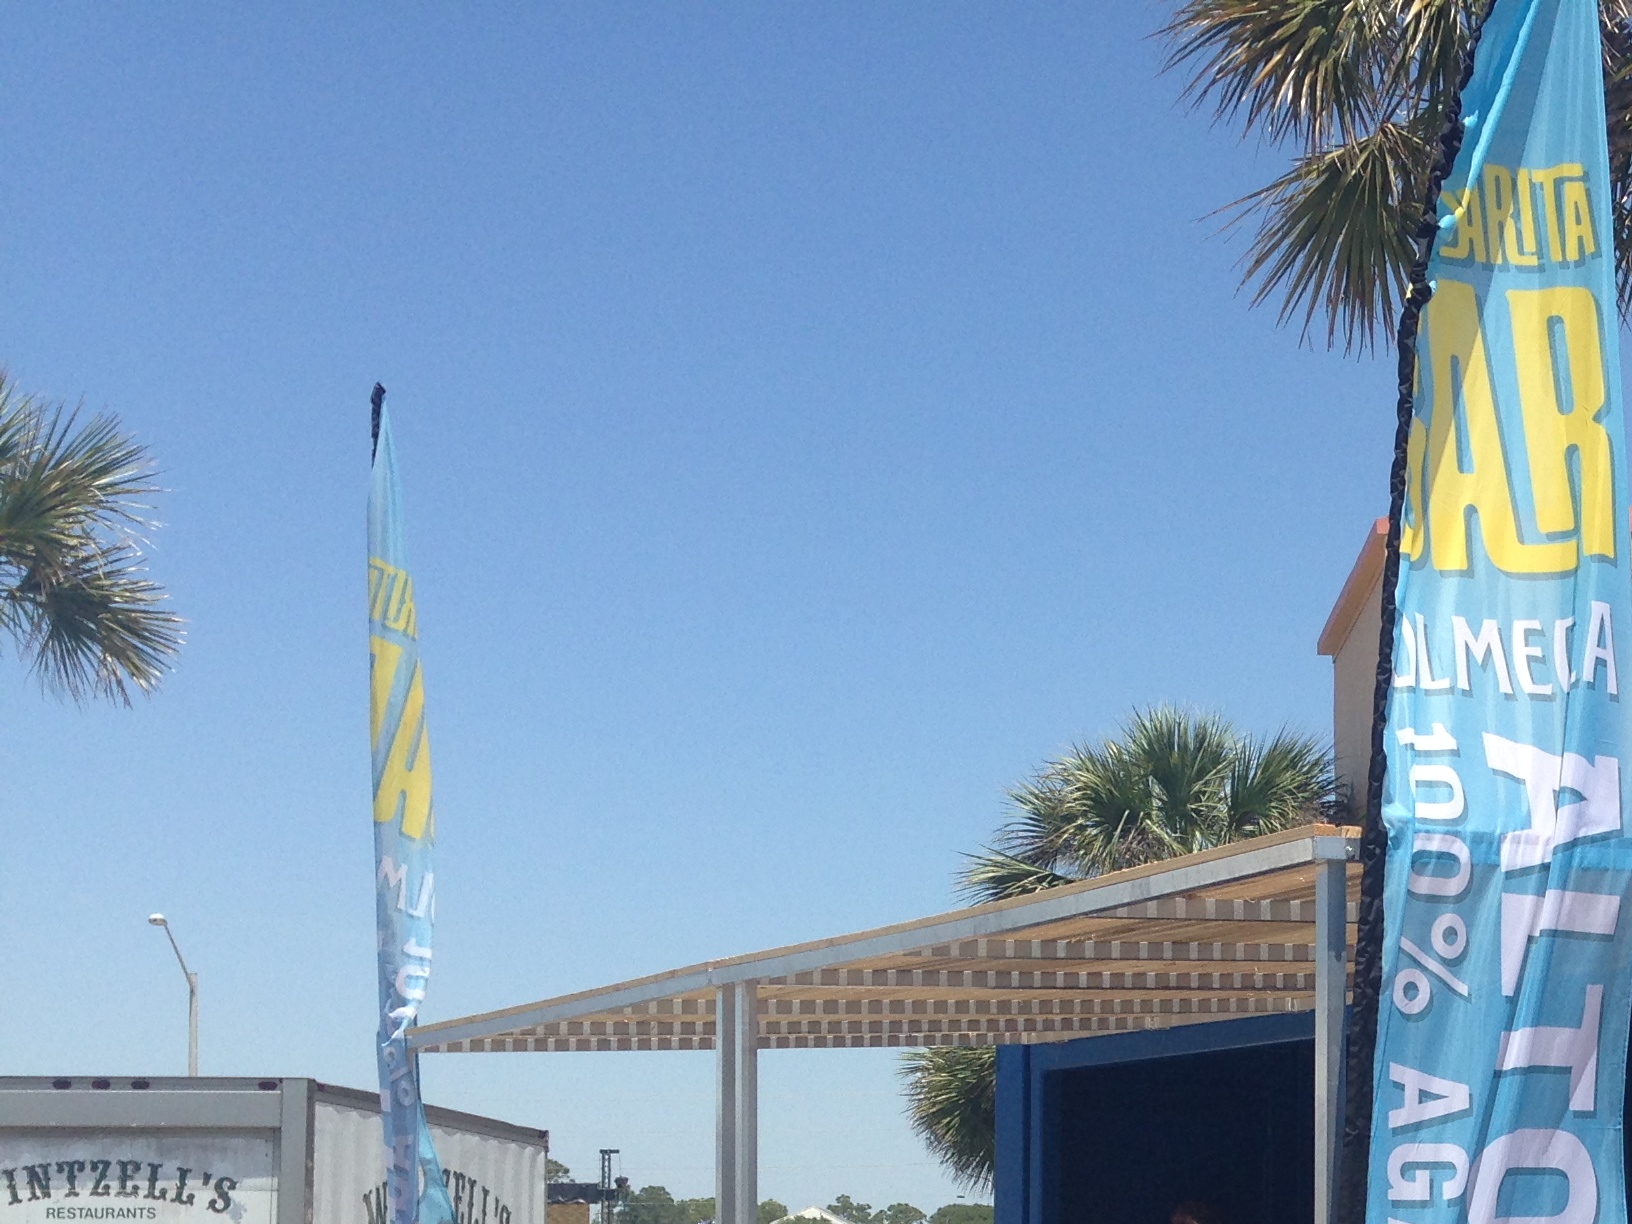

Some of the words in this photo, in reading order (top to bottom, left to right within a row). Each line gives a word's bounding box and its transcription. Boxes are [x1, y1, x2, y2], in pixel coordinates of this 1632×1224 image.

[1392, 721, 1471, 1018] 100%
[1, 1159, 238, 1214] INTZELL'S
[46, 1206, 156, 1220] RESTAURANTS
